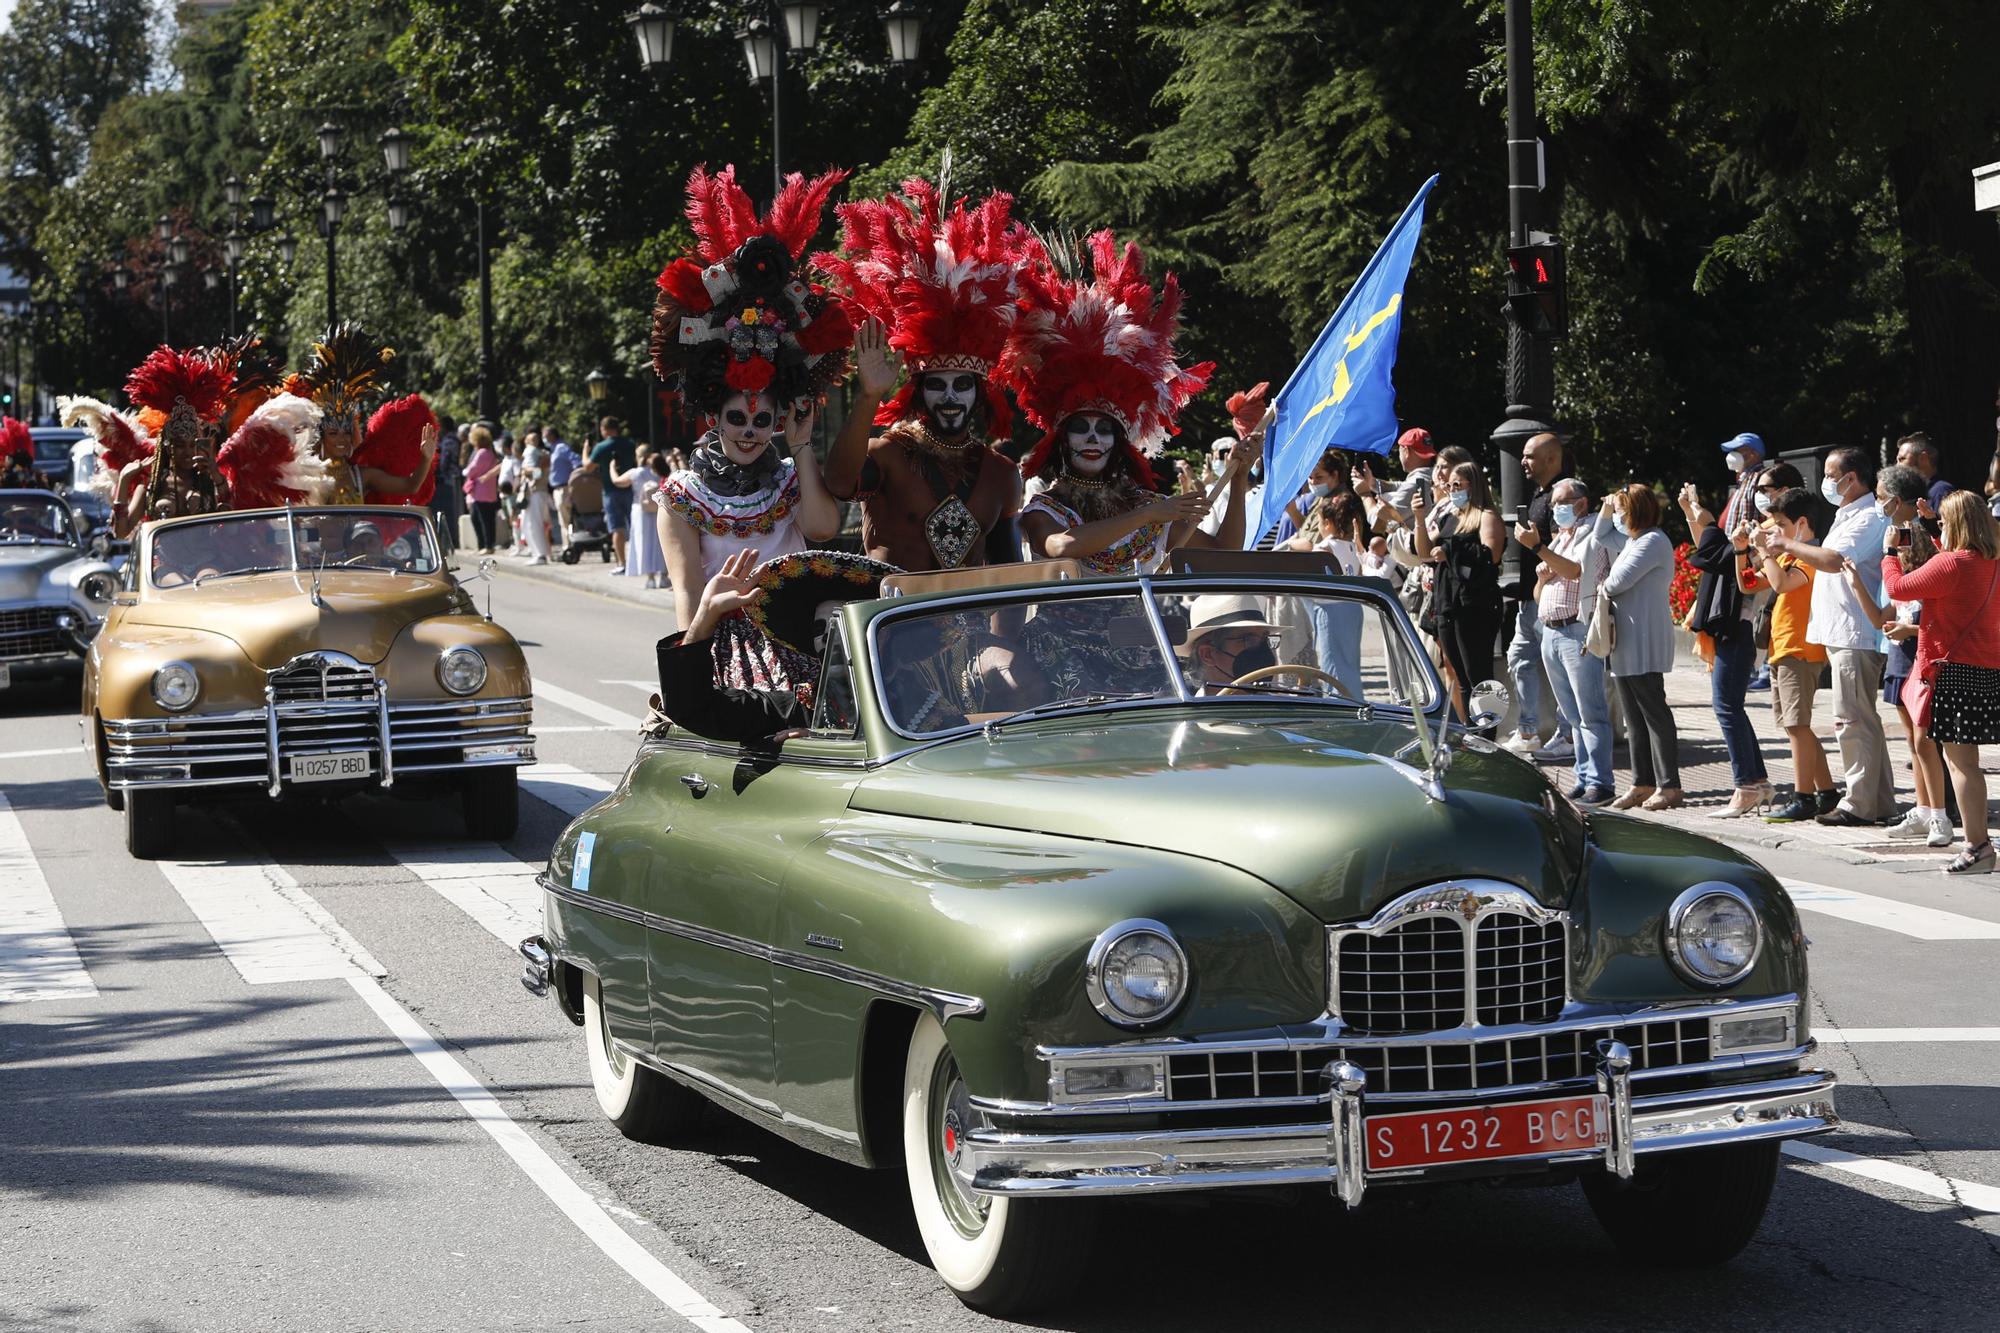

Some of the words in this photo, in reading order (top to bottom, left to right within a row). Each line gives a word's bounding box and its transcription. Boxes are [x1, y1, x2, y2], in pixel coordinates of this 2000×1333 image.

[295, 761, 304, 777] H
[306, 760, 338, 776] 0257
[341, 757, 366, 774] BBD
[1377, 1127, 1394, 1158] S
[1420, 1116, 1502, 1154] 1232
[1527, 1107, 1592, 1144] BCG
